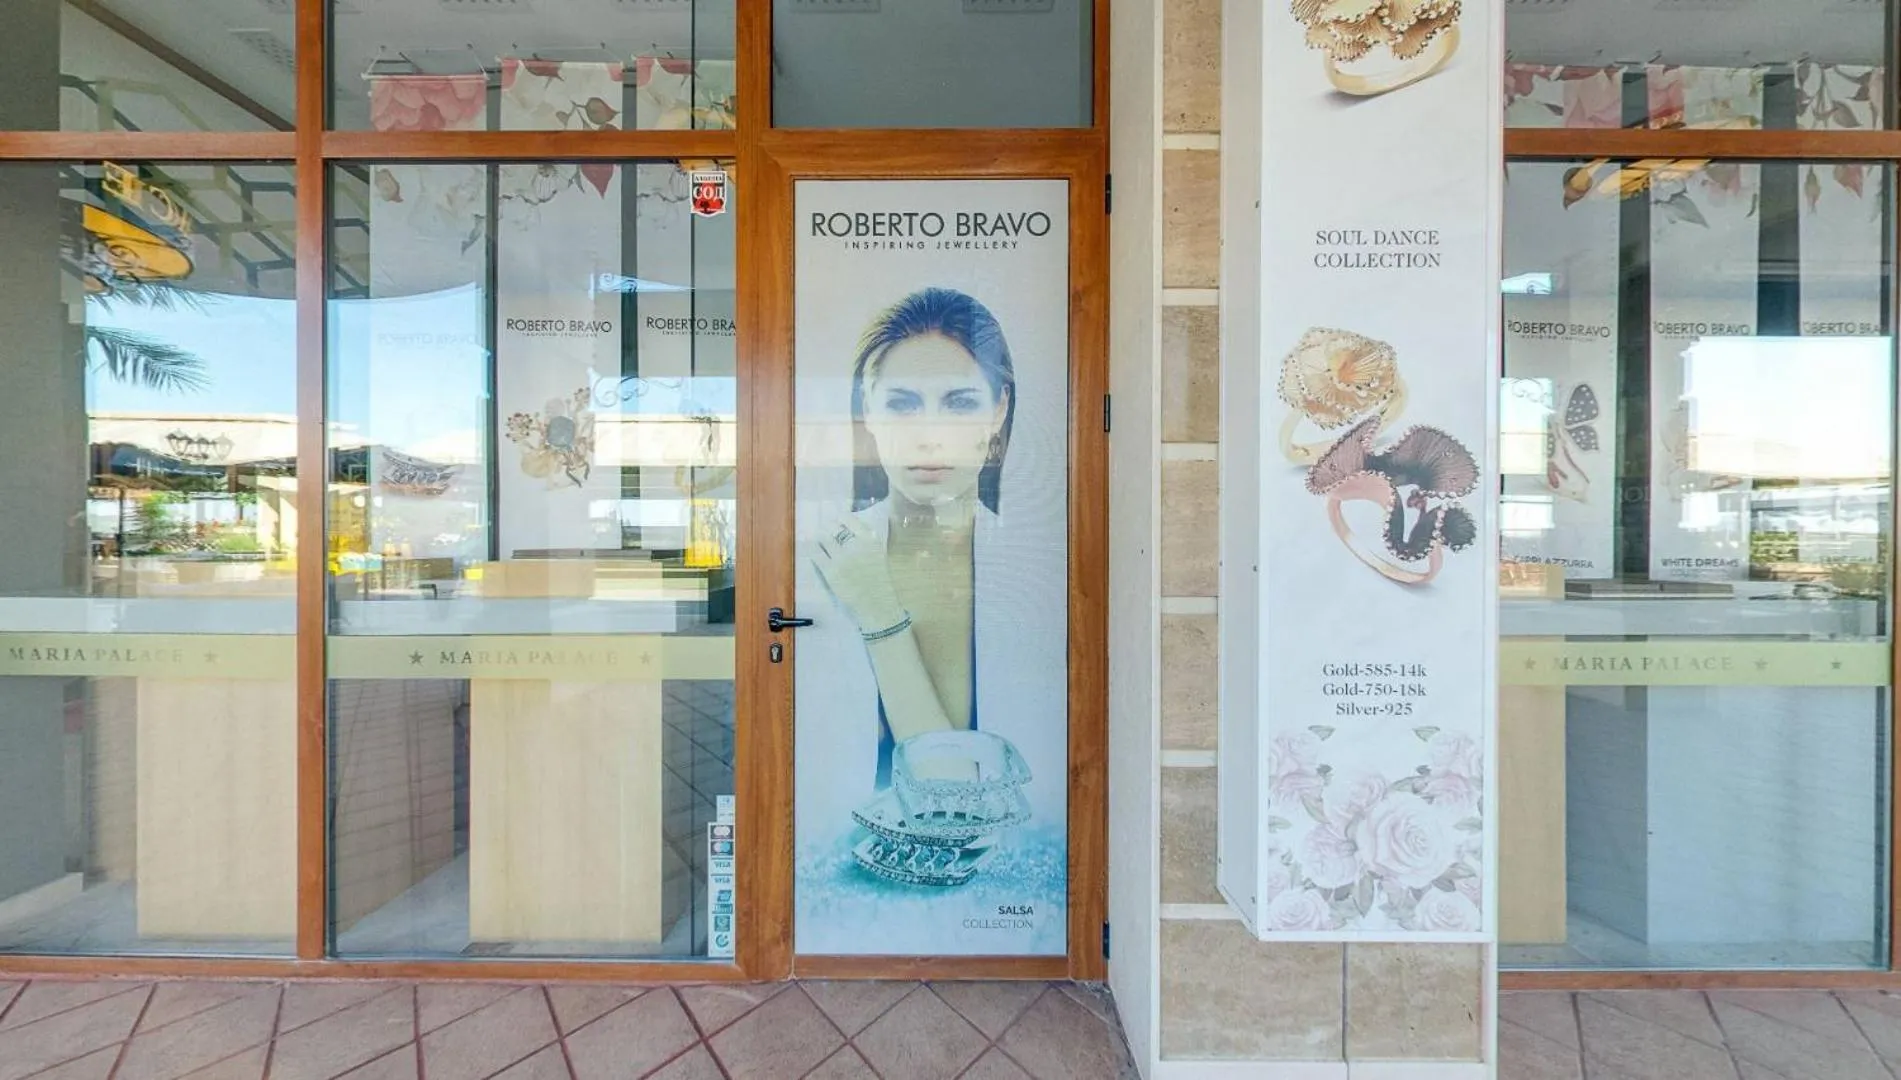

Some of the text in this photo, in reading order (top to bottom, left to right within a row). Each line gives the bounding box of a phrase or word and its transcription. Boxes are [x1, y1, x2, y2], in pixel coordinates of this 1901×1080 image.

[811, 211, 1052, 238] ROBERTO BRAVO
[844, 241, 1019, 250] INSPIRING JEWELLERY
[1315, 230, 1440, 246] SOUL DANCE
[1314, 252, 1441, 268] COLLECTION
[506, 318, 612, 333] ROBERTO BRAVO
[646, 316, 708, 331] ROBERTO
[1570, 323, 1611, 338] BRAVO
[1711, 322, 1749, 336] BRAVO
[9, 647, 183, 663] MARIA PALACE
[440, 650, 618, 665] MARIA PALACE
[1322, 663, 1428, 677] Gold-585-14k
[1553, 656, 1733, 671] MARIA PALACE
[1322, 682, 1428, 697] Gold-750-18k
[1335, 702, 1414, 716] Silver-925
[998, 905, 1034, 916] SALSA
[962, 919, 1033, 929] COLLECTION
